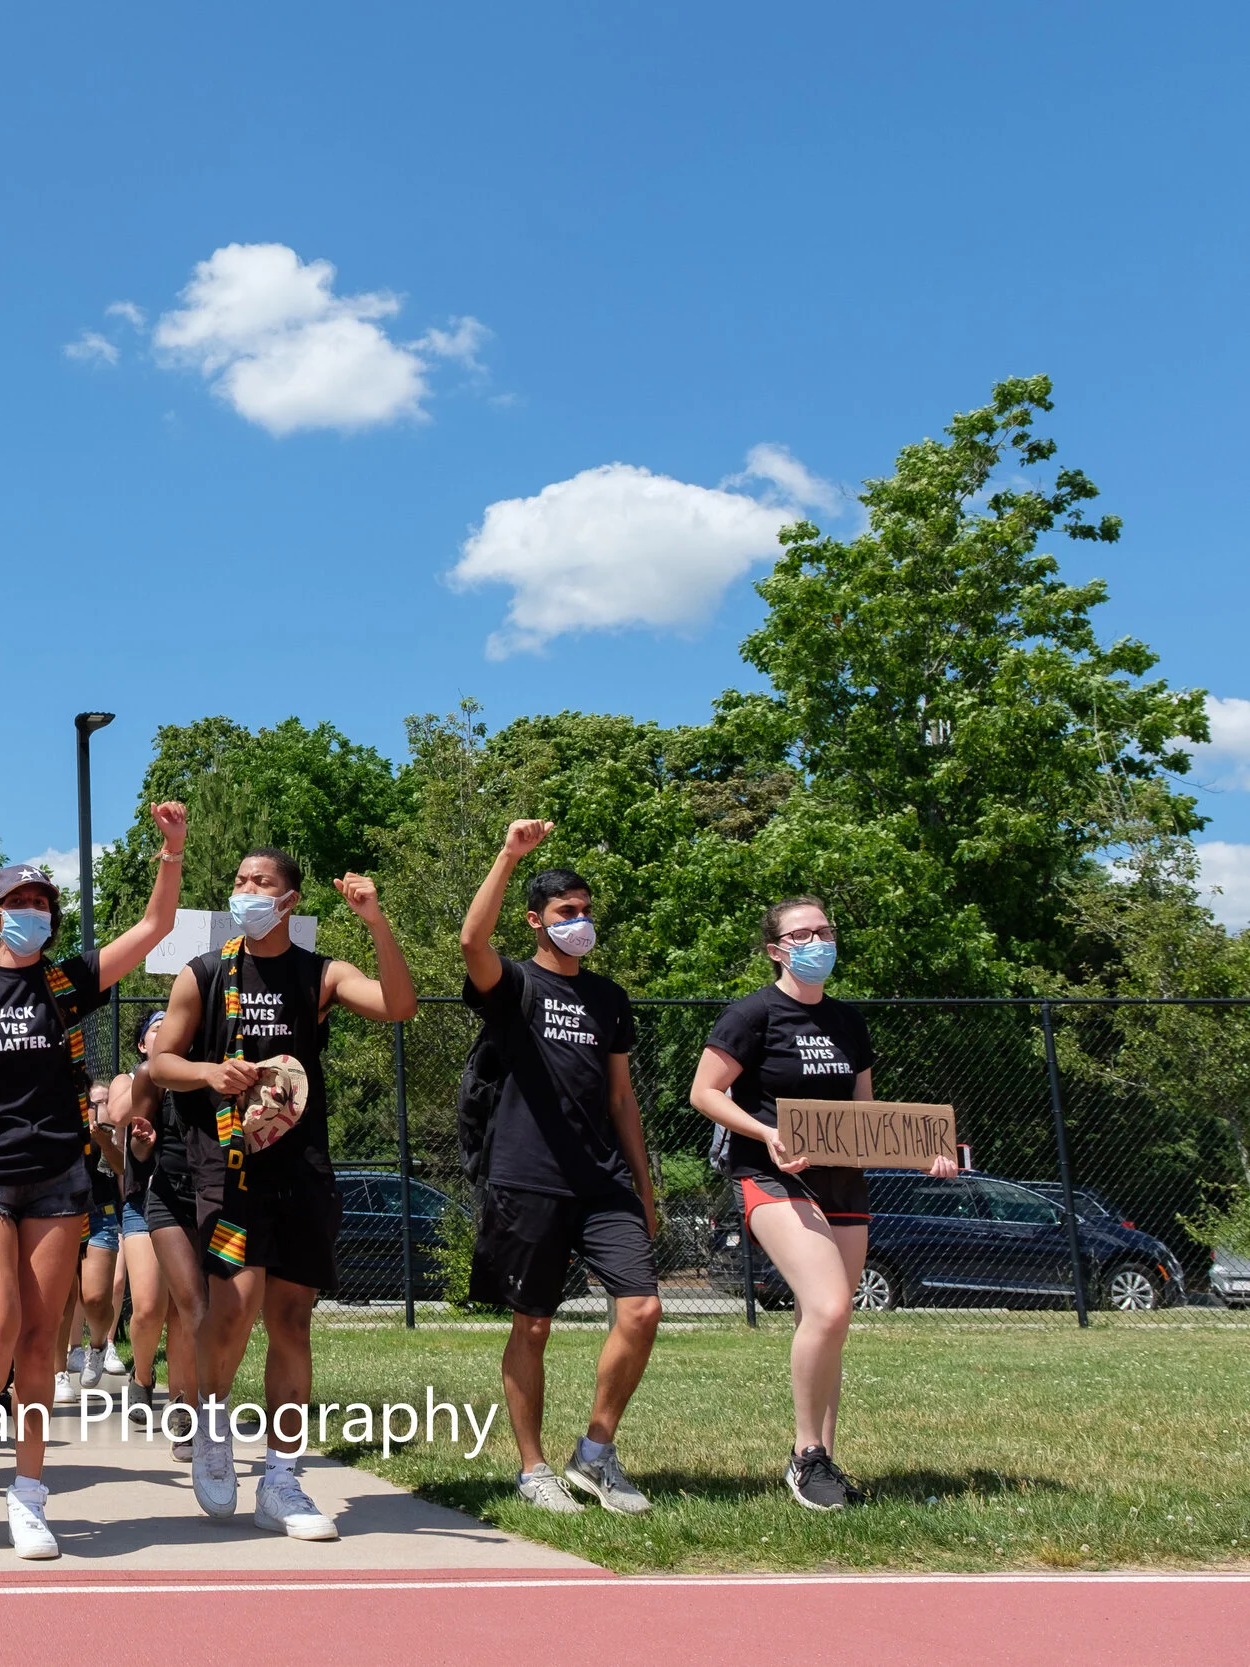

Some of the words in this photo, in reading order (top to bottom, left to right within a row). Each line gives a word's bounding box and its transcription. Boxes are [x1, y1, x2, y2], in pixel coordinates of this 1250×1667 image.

[240, 992, 284, 1006] BLACK
[544, 998, 587, 1016] BLACK
[544, 1011, 580, 1028] LIVES
[543, 1026, 599, 1046] MATTER.
[795, 1035, 835, 1047] BLACK
[799, 1048, 835, 1060] LIVES
[803, 1062, 854, 1075] MATTER.
[790, 1108, 850, 1158] BLACK
[853, 1110, 900, 1158] LIVES
[902, 1112, 954, 1159] MATTER
